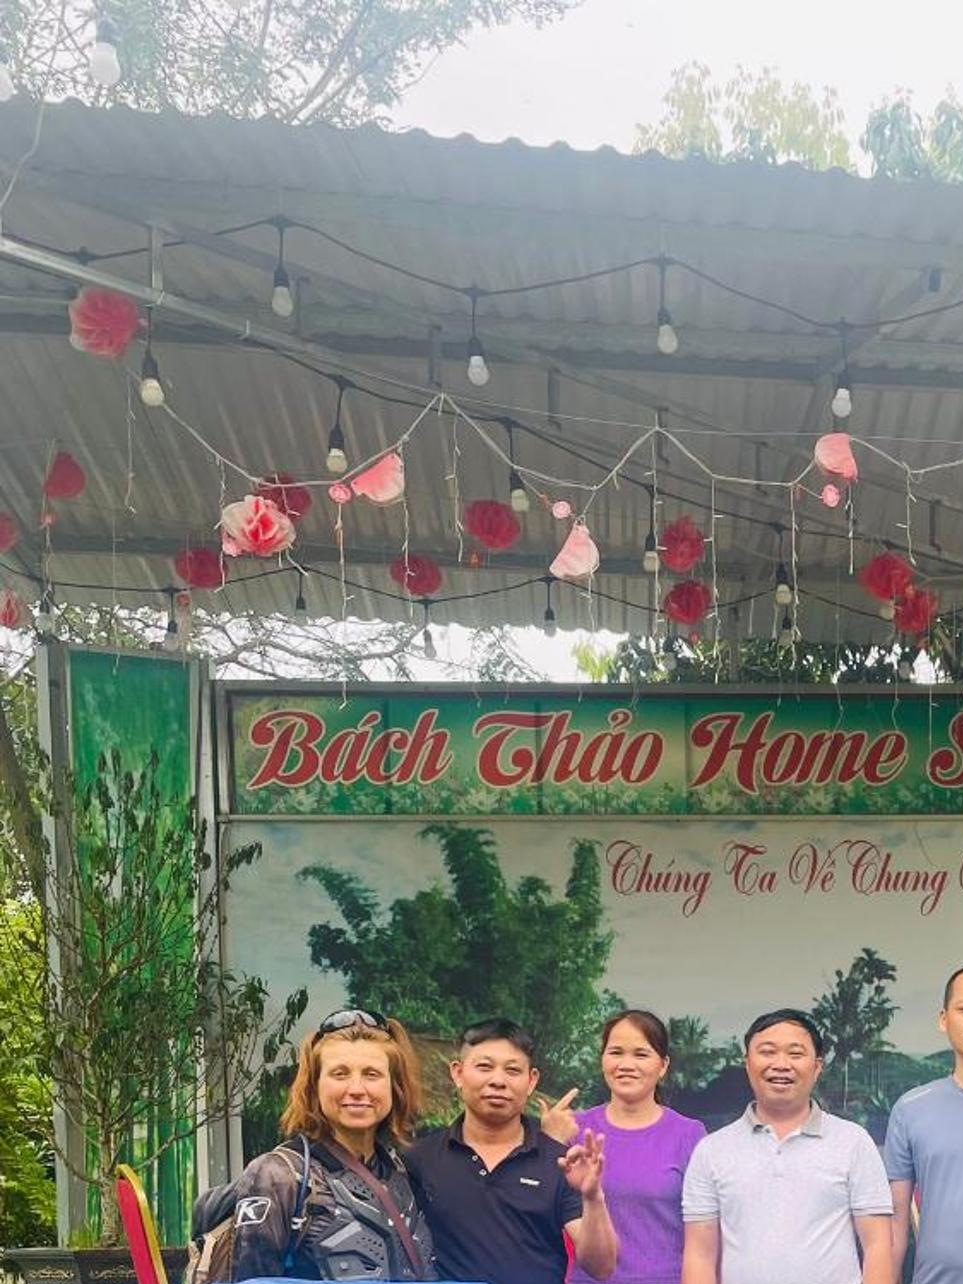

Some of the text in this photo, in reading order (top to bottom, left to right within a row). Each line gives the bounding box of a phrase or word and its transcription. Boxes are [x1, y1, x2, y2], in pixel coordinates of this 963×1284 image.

[247, 709, 453, 790] Bách
[473, 708, 665, 788] Thảo
[688, 710, 908, 795] Home
[606, 840, 711, 918] Chúng
[723, 840, 777, 895] Ta
[847, 840, 948, 916] Chung
